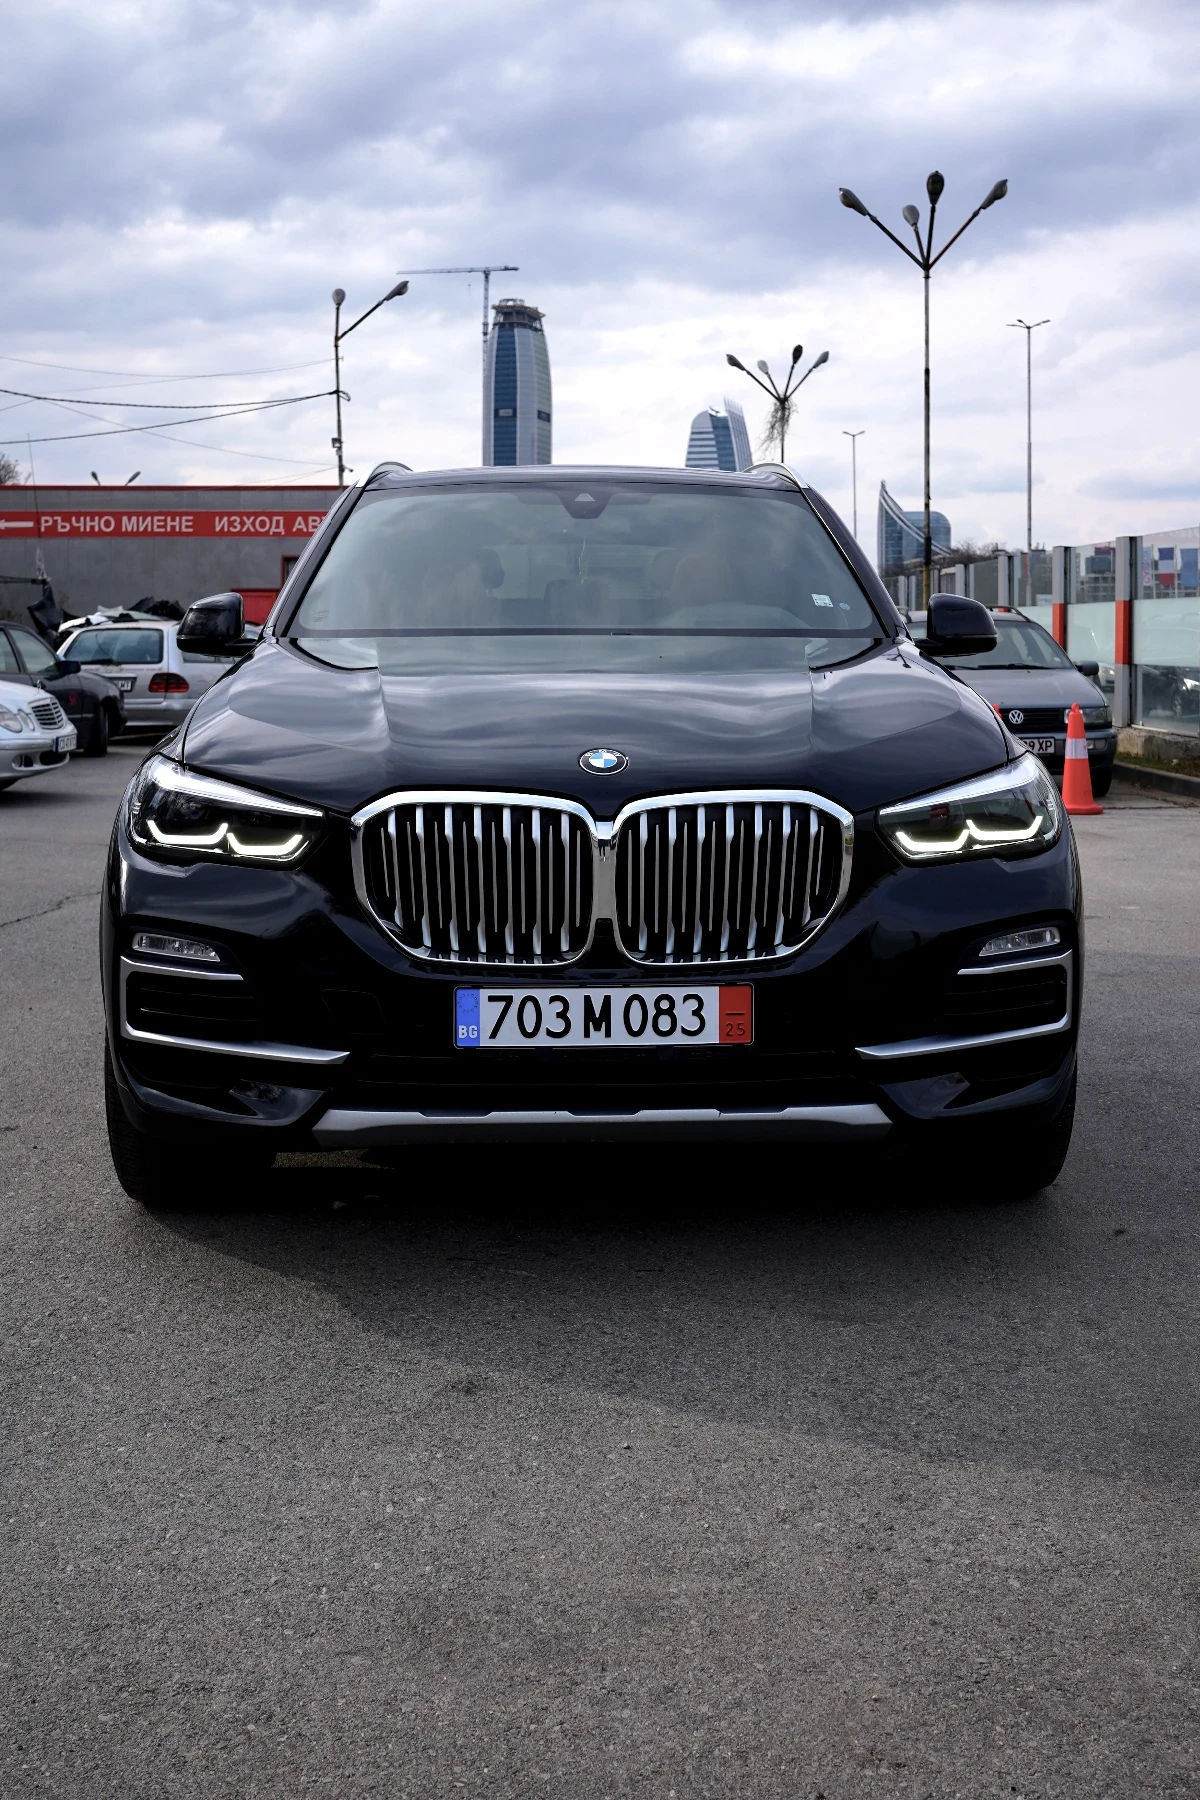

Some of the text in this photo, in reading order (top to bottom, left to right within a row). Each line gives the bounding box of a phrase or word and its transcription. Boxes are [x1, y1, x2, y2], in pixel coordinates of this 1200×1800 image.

[40, 516, 194, 533] РЪЧНО МИЕНЕ
[214, 515, 325, 535] ИЗХОД АВ
[487, 992, 706, 1040] 703 M 083
[458, 1024, 478, 1039] BG
[725, 1021, 746, 1037] 25
